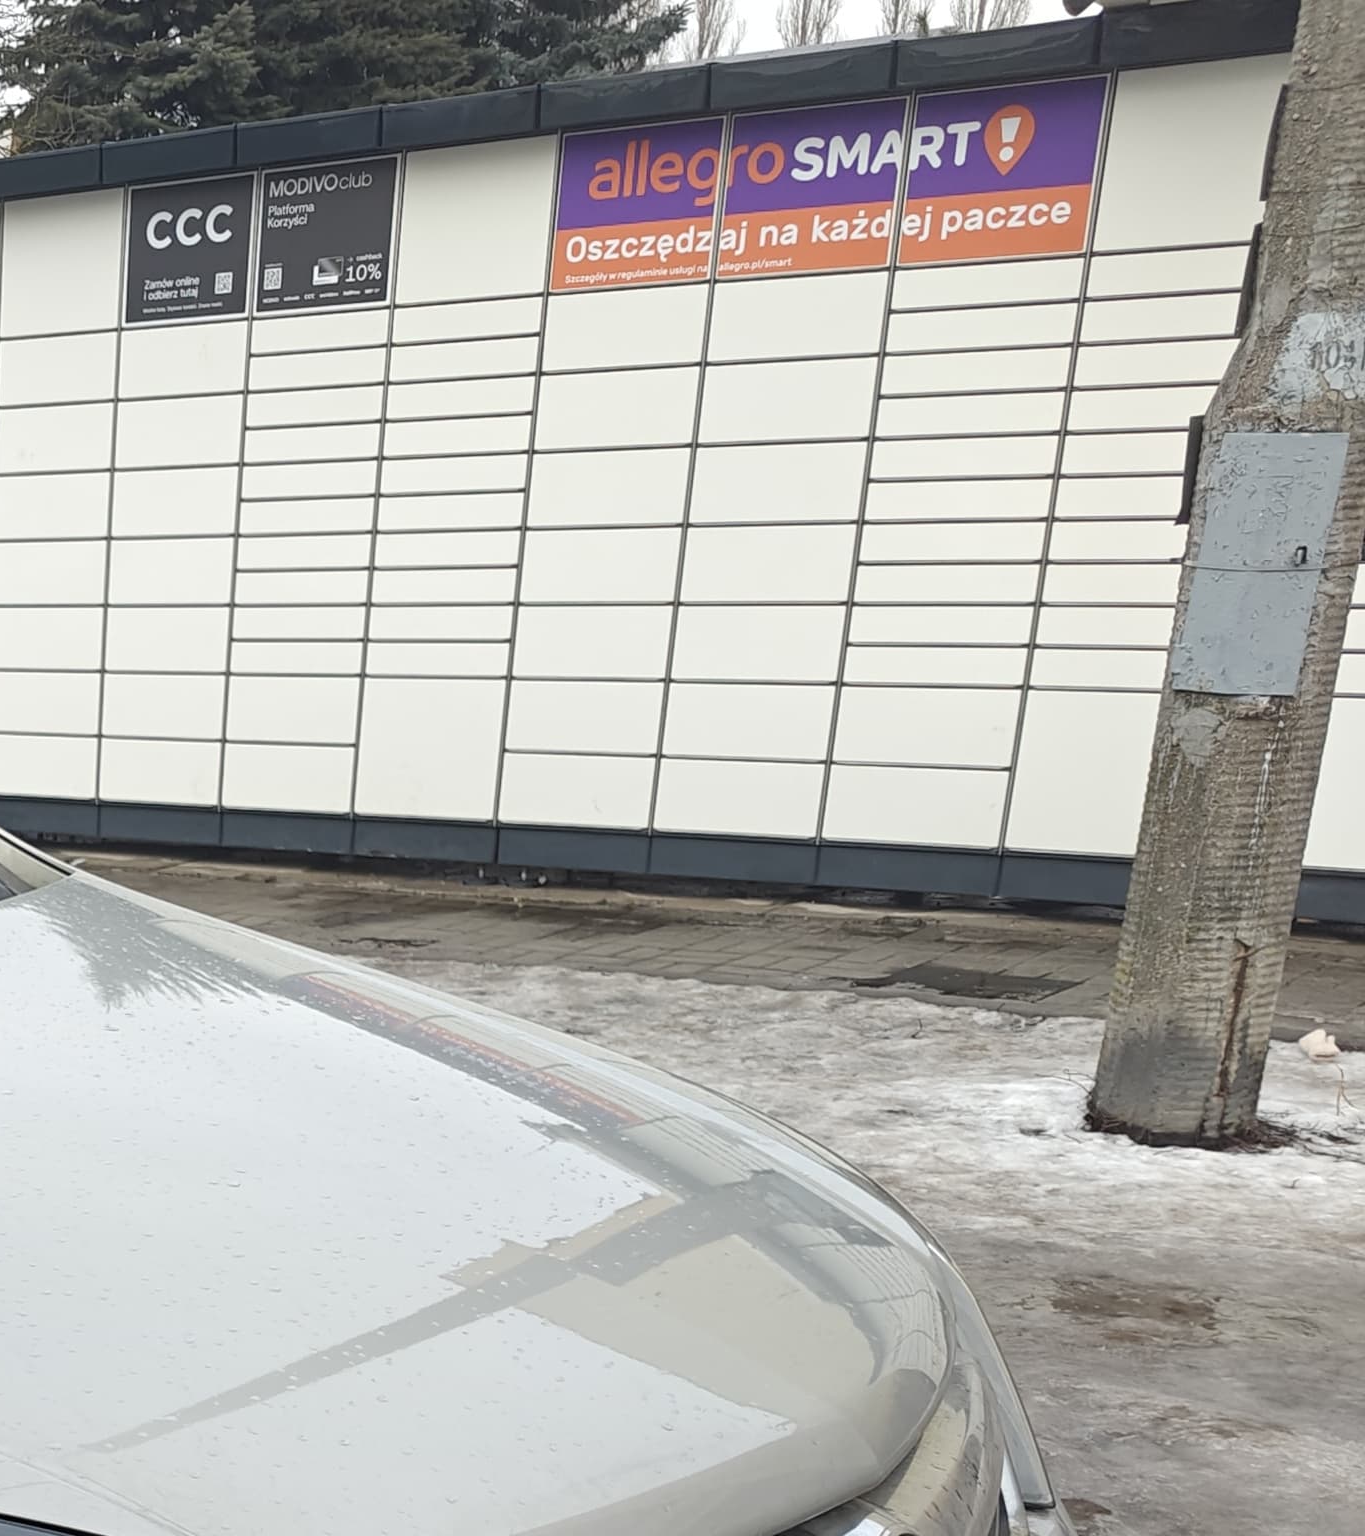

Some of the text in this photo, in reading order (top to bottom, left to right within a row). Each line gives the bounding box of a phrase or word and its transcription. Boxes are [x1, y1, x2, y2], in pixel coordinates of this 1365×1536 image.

[588, 138, 785, 206] allegro
[268, 203, 315, 217] Platforma
[145, 203, 234, 250] CCC
[267, 214, 308, 230] Korzyści
[566, 200, 1072, 262] Oszczędzaj na każdej paczce
[345, 263, 382, 282] 10%
[144, 276, 200, 290] Zamów online
[148, 289, 178, 300] odbierz
[180, 286, 199, 298] tutaj
